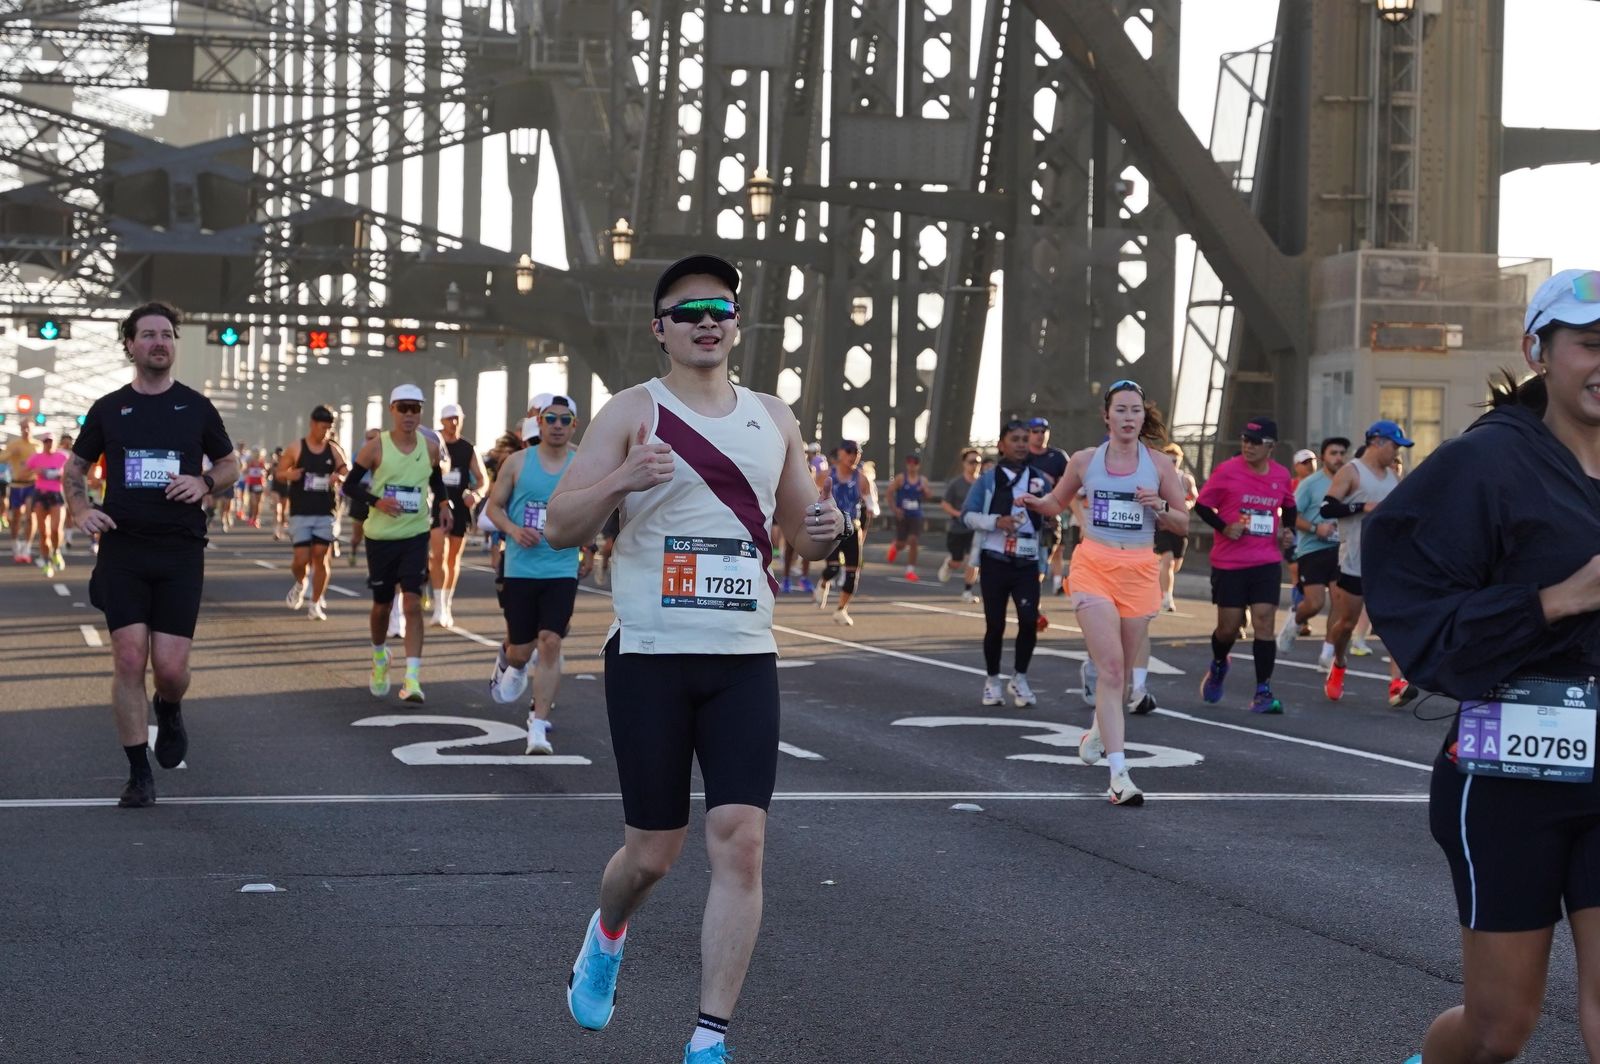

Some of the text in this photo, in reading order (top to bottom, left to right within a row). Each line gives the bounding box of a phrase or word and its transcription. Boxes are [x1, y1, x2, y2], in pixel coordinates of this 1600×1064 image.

[126, 472, 132, 480] 2
[134, 472, 141, 480] A
[1242, 494, 1279, 506] SYDNEY
[1111, 511, 1140, 522] 21649
[673, 538, 691, 551] tcs
[668, 576, 752, 596] 1 H 17821
[1562, 699, 1586, 707] TATA
[350, 714, 593, 766] 2
[890, 716, 1205, 768] 3
[1463, 734, 1587, 761] 2 A 20769
